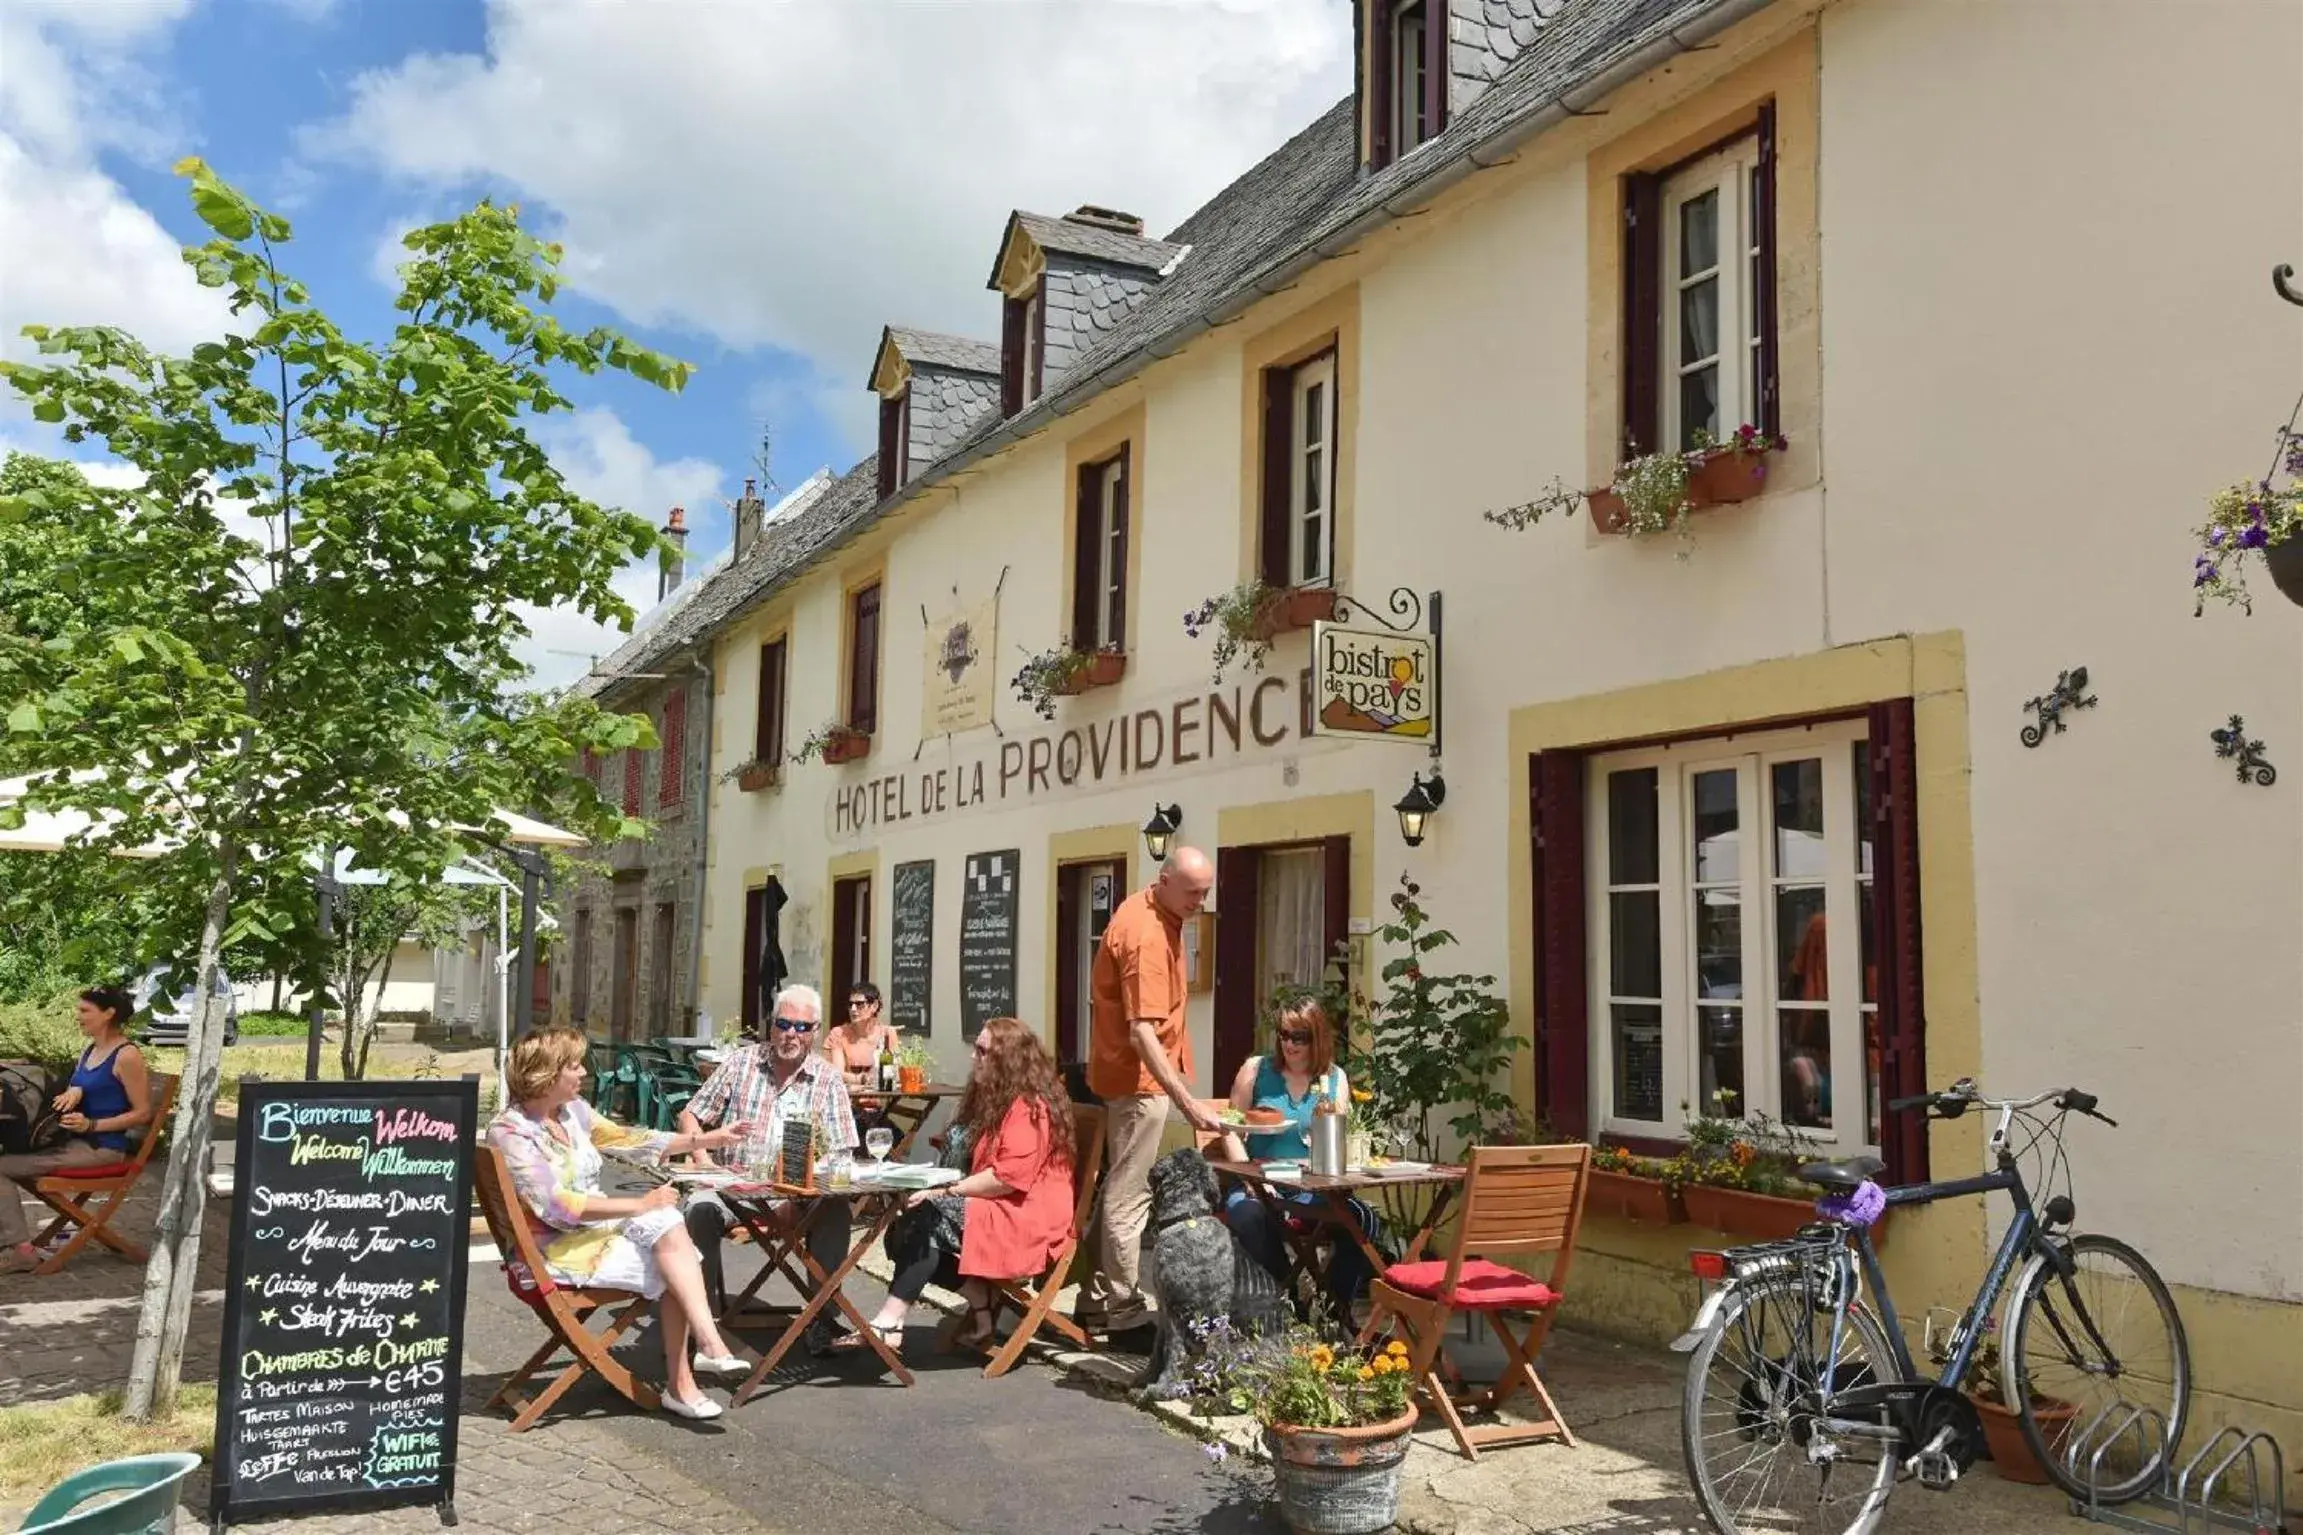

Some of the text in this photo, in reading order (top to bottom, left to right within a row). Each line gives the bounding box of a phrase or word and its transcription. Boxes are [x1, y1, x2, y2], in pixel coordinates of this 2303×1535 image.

[1326, 634, 1425, 684] bistrot
[1324, 674, 1421, 716] de pays
[836, 773, 912, 833] HOTEL
[921, 769, 947, 815] DE
[956, 760, 985, 807] LA
[259, 1102, 458, 1145] Bienvenue Welkom
[290, 1133, 455, 1183] Welcome Willkommen
[287, 1219, 407, 1265] Menu du Jour
[263, 1272, 414, 1306] Cuisine Auvergnate
[279, 1302, 396, 1338] Steak Frites
[346, 1345, 372, 1367] de
[240, 1383, 254, 1400] à
[256, 1380, 309, 1398] Partir
[384, 1360, 444, 1393] €45
[238, 1401, 355, 1424] TARTES MAISON
[391, 1408, 426, 1421] PIES
[266, 1438, 310, 1451] TAART
[377, 1451, 442, 1475] GRATUIT
